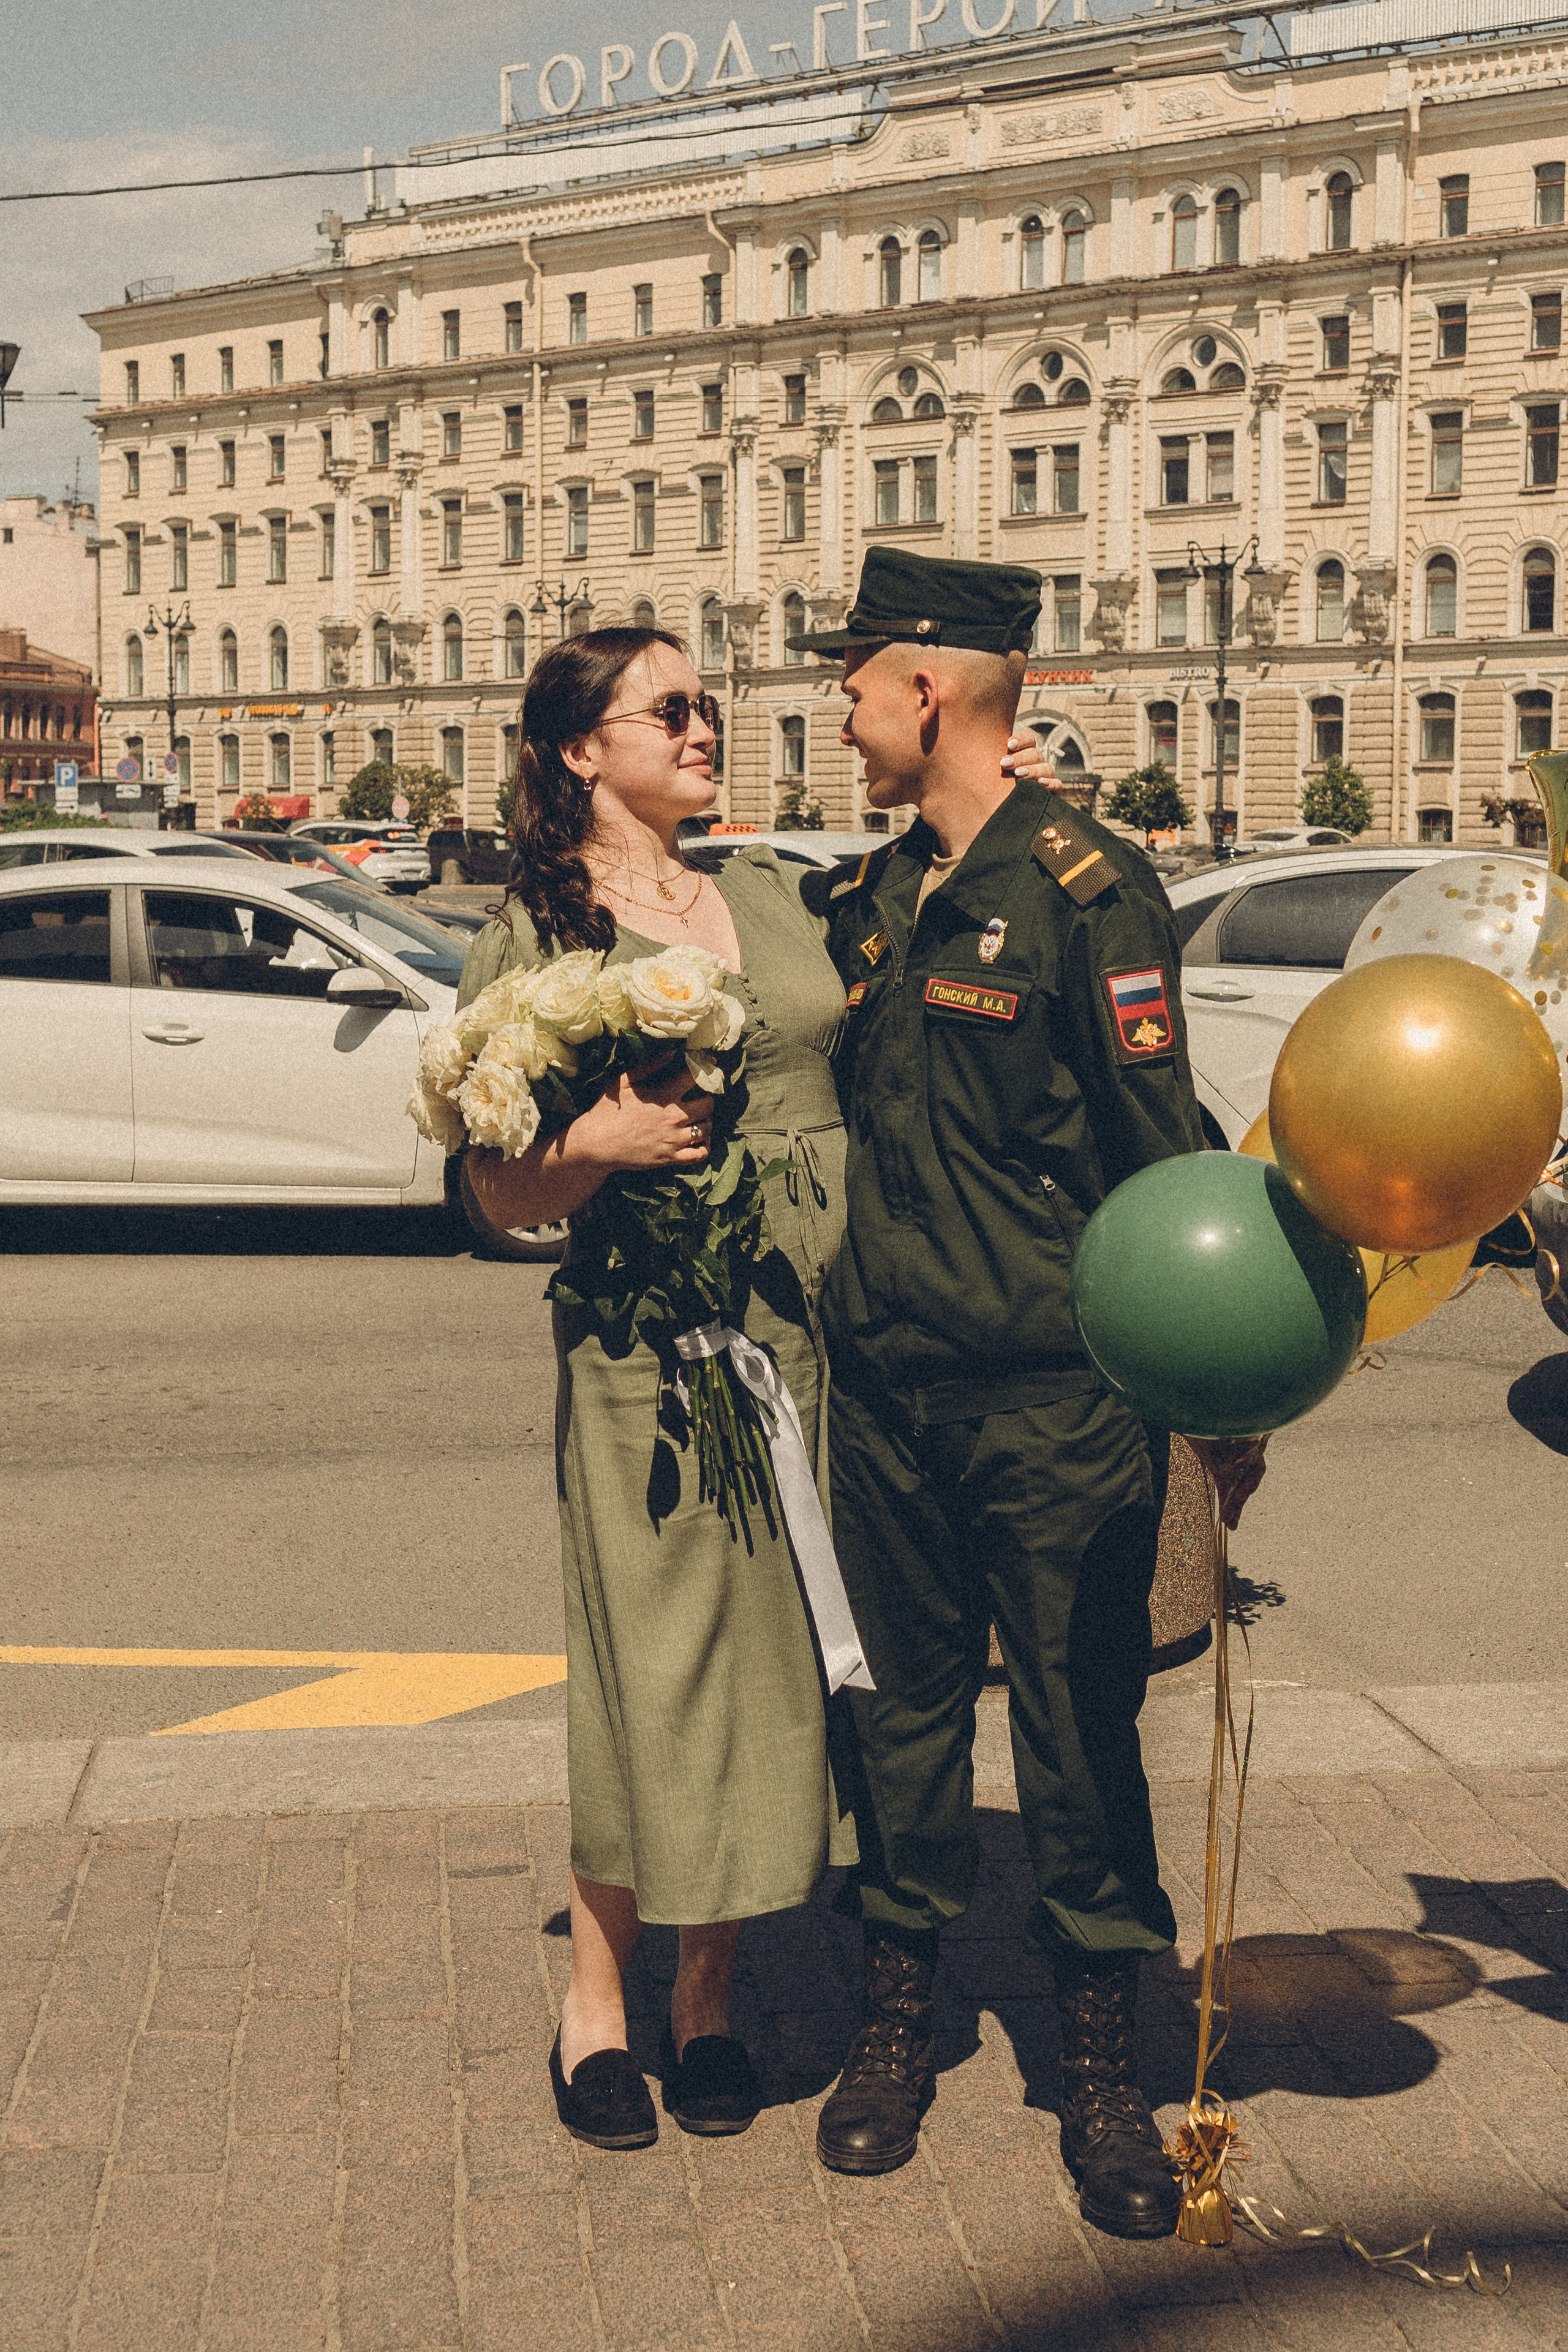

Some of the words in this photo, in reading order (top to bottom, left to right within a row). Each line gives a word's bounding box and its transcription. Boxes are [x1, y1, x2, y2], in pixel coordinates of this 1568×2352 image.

[1023, 669, 1093, 685] КУНЧИК
[1170, 666, 1210, 679] BISTRO
[61, 766, 74, 785] P
[932, 986, 979, 1006] ГОНСКИЙ
[982, 996, 1006, 1012] М.А.
